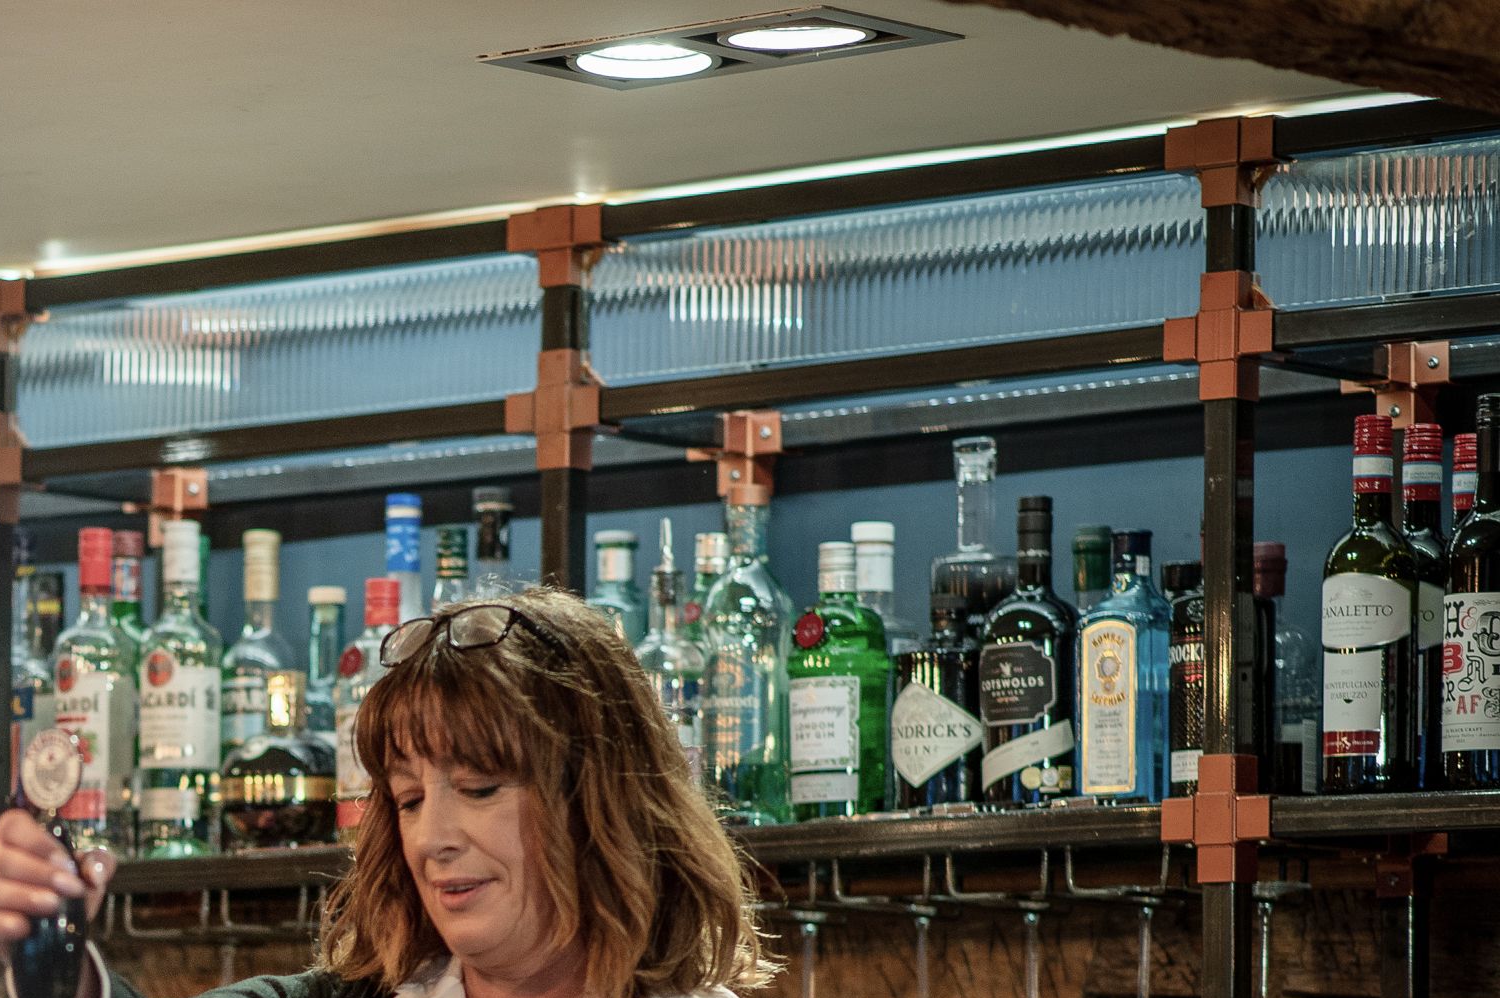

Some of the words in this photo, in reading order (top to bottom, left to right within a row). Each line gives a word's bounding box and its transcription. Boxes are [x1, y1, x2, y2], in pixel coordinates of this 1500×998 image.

[1444, 601, 1477, 638] HE
[1169, 644, 1204, 667] ROCK
[981, 675, 1044, 692] COTSWOLDS
[1326, 680, 1380, 690] NTEPULCIANO
[894, 723, 972, 739] NDRICK'S
[904, 745, 930, 756] GIN
